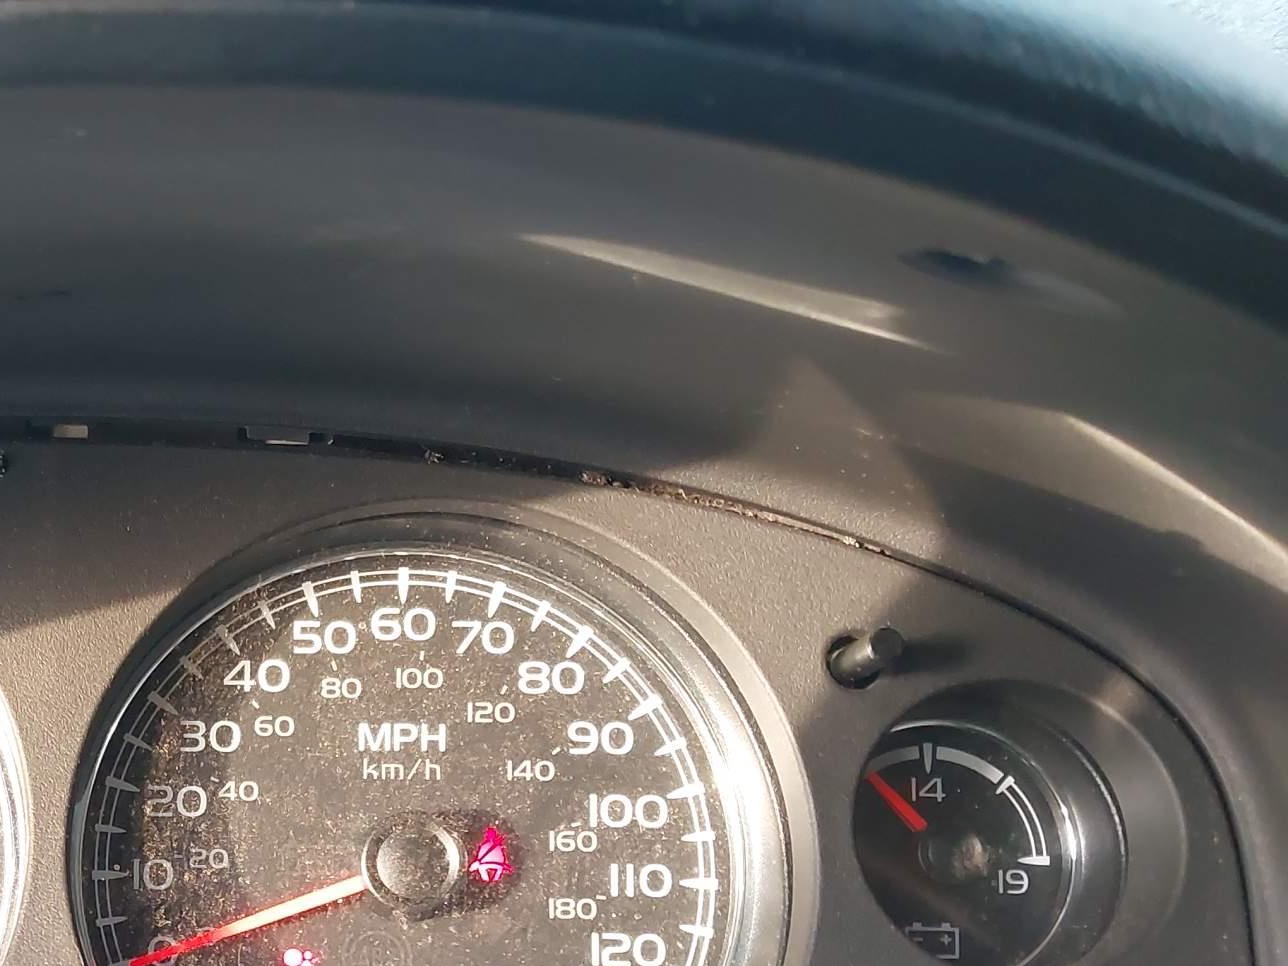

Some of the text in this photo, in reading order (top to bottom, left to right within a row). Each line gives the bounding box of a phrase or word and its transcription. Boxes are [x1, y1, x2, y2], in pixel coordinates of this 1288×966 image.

[292, 620, 357, 655] 50
[370, 608, 435, 642] 60
[452, 620, 516, 655] 70
[224, 659, 290, 693] 40
[320, 678, 362, 699] 80
[395, 668, 443, 689] 100
[518, 661, 584, 694] 80
[253, 716, 295, 737] 60
[467, 702, 515, 723] 120
[180, 719, 241, 753] 30
[357, 723, 447, 751] MPH
[568, 721, 633, 755] 90
[362, 758, 442, 781] km/h
[506, 761, 556, 781] 140
[149, 784, 207, 817] 20
[218, 781, 259, 801] 40
[911, 777, 946, 802] 14
[588, 794, 668, 827] 100
[548, 831, 597, 852] 160
[189, 848, 229, 869] 20
[133, 859, 173, 890] 10
[610, 864, 672, 897] 110
[998, 869, 1030, 894] 19
[548, 899, 597, 919] 180
[591, 932, 666, 966] 120
